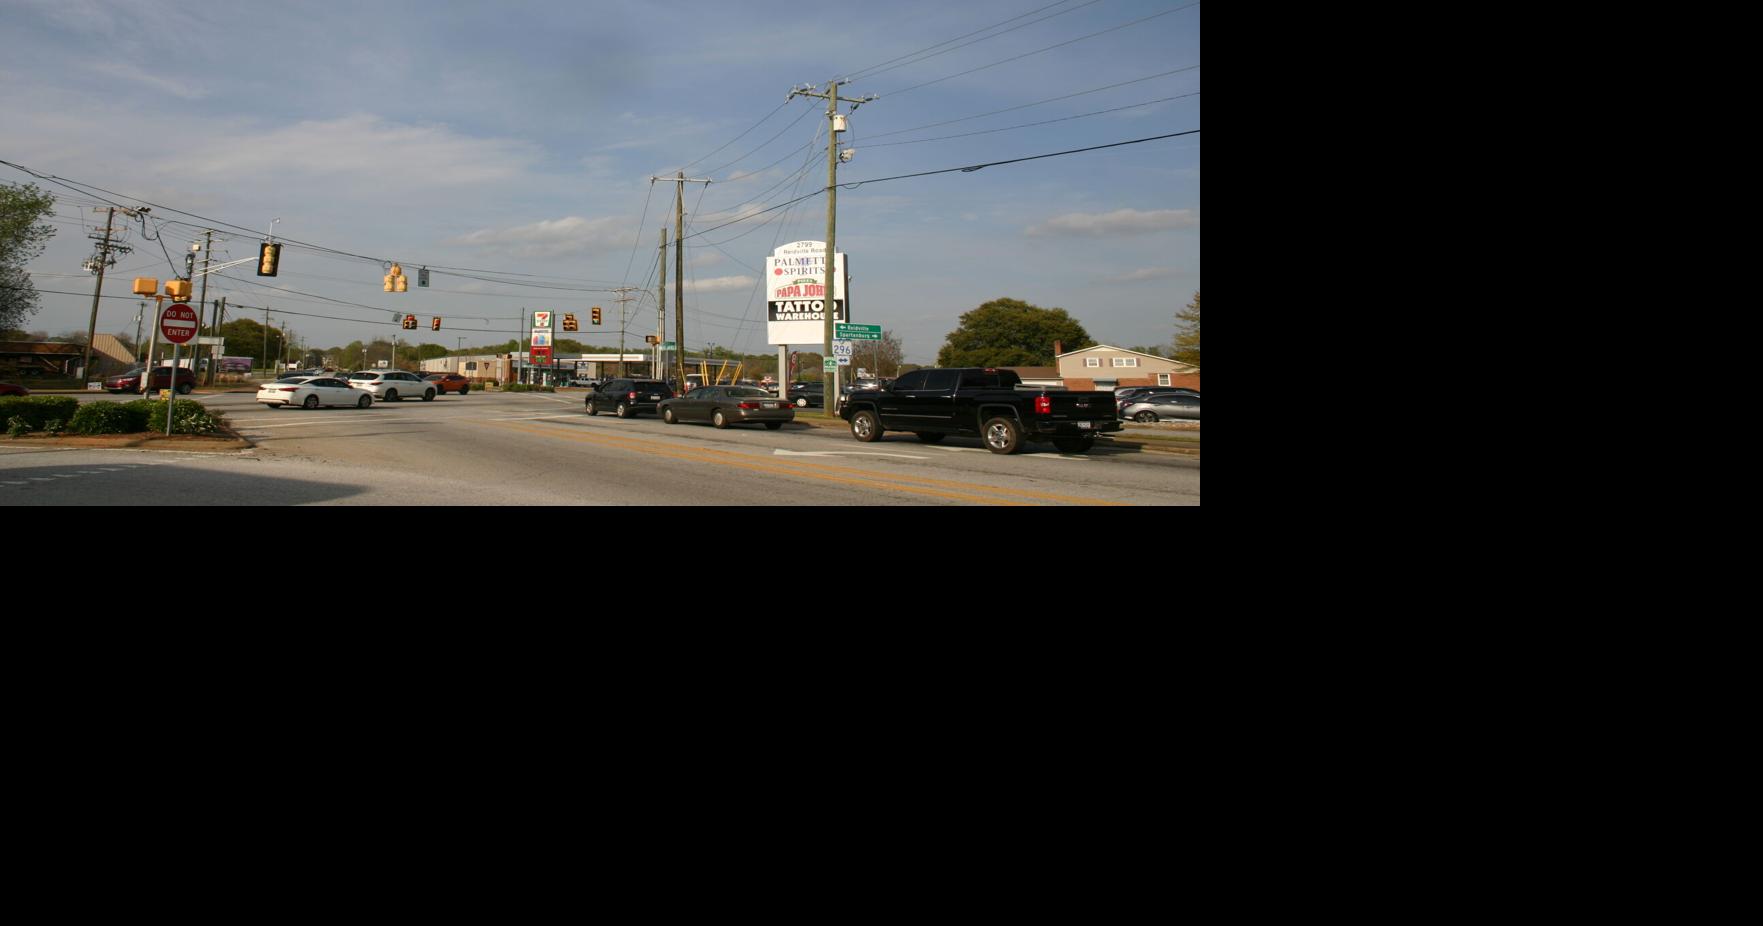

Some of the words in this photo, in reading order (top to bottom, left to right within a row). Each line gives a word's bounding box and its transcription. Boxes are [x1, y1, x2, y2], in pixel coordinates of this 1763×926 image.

[775, 257, 826, 267] PALMETT
[784, 267, 826, 276] SPIRITS
[776, 285, 801, 298] PAPA
[803, 284, 826, 297] JOH
[775, 300, 837, 313] TATTO
[166, 310, 177, 318] DO
[181, 311, 193, 319] NOT
[776, 312, 839, 321] WAREHOUE
[168, 328, 190, 337] ENTER
[834, 345, 851, 355] 296
